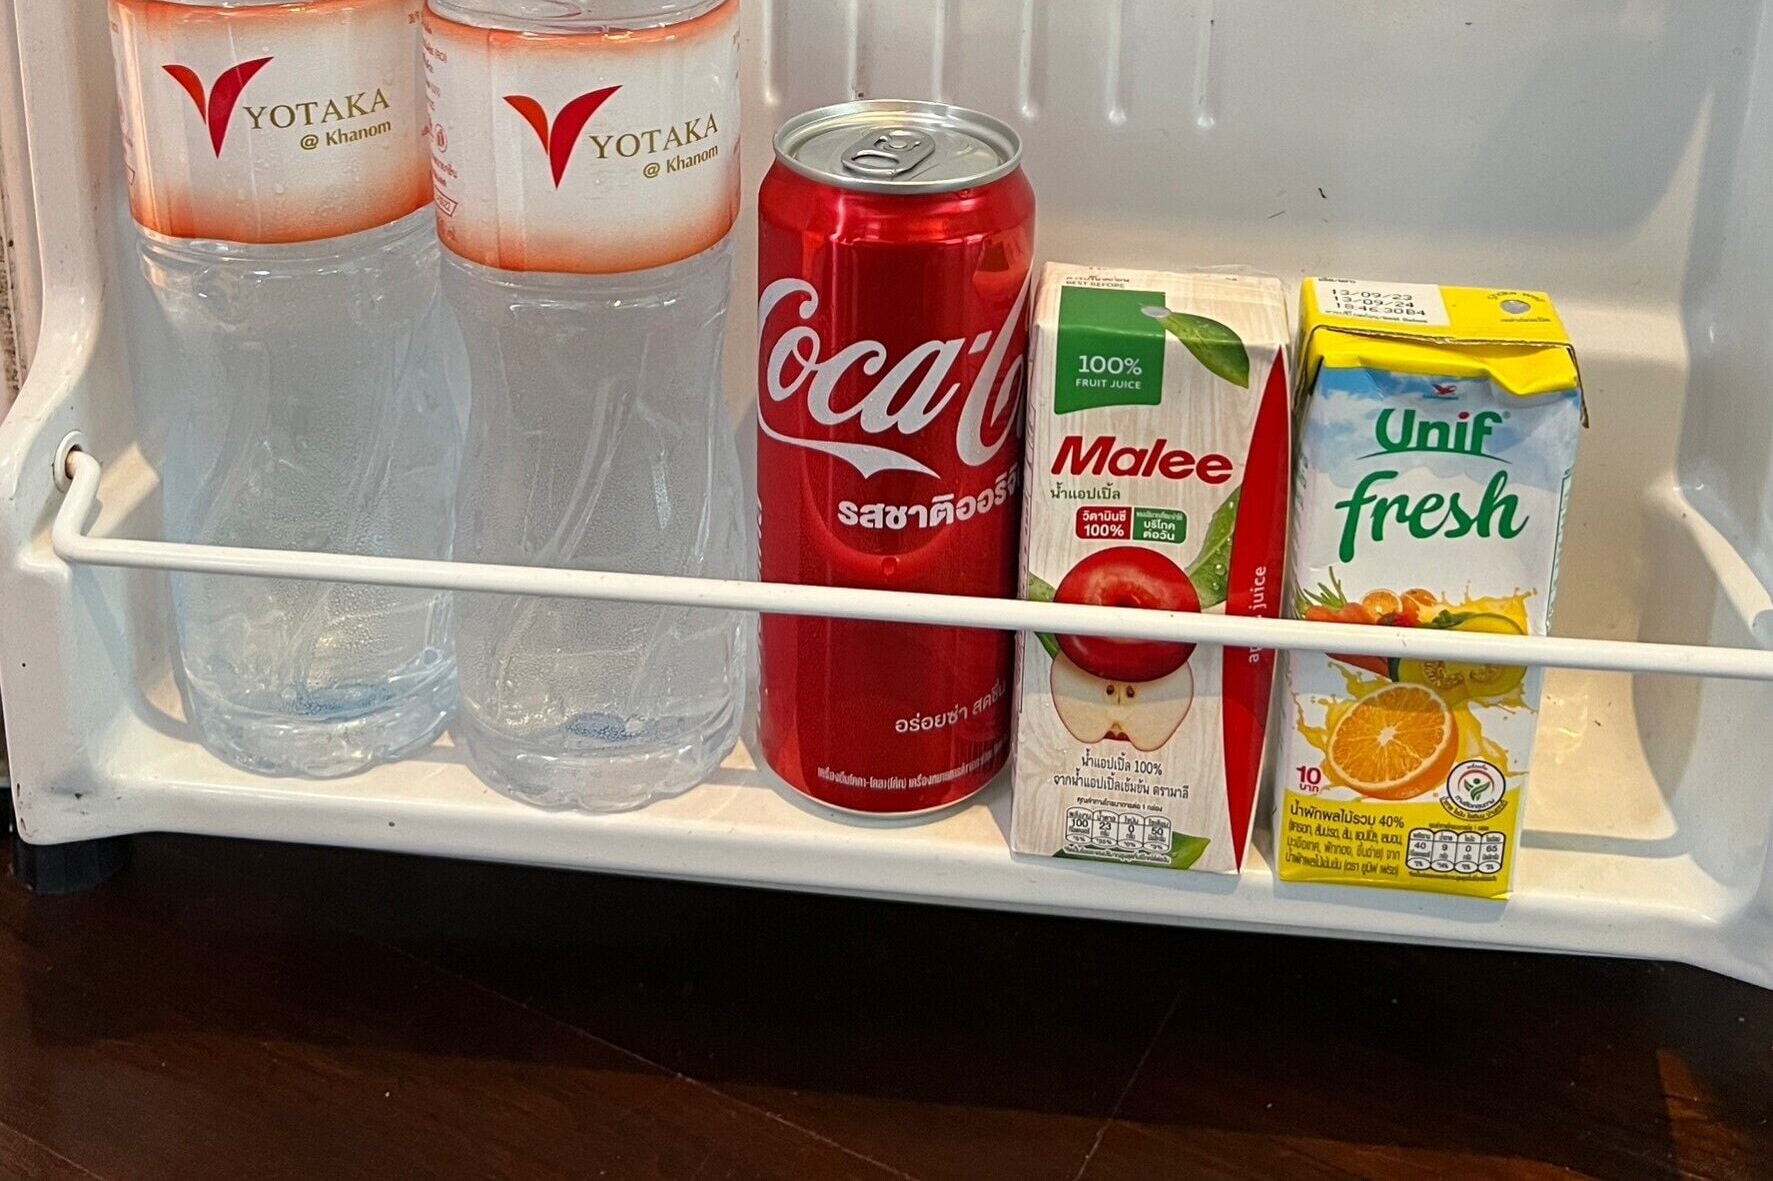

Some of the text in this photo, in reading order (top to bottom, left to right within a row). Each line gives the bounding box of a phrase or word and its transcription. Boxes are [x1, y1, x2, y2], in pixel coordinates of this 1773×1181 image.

[244, 88, 391, 130] YOTAKA
[300, 121, 391, 151] @ Khanom
[589, 113, 719, 159] YOTAKA
[643, 145, 719, 179] @ Khanom
[1332, 289, 1412, 301] 13/09/23
[1335, 296, 1414, 307] 13/09/24
[1079, 355, 1142, 375] 100%
[1076, 378, 1142, 389] FRUIT JUICE
[1375, 408, 1502, 454] Unif
[1051, 435, 1233, 485] Malee
[1050, 482, 1121, 500] น้ำแอปเปิ้ล
[1083, 510, 1126, 522] วิตามินซี
[1143, 519, 1176, 531] บริโภค
[1335, 470, 1530, 563] fresh
[1084, 524, 1124, 537] 100%
[1143, 529, 1175, 541] ต่อวัน
[1249, 566, 1267, 611] juice
[895, 704, 968, 733] อร่อยซ่า
[1081, 748, 1163, 775] น้ำแอปเปิ้ล 100%
[1296, 765, 1322, 785] 10
[1054, 768, 1150, 795] จากน้ำแอปเปิ้ลเข้มข้น
[1072, 818, 1088, 827] 100
[1099, 821, 1112, 830] 23
[1127, 824, 1135, 833] 0
[1291, 799, 1376, 829] น้ำผักผลไม้รวม
[1379, 815, 1405, 829] 40%
